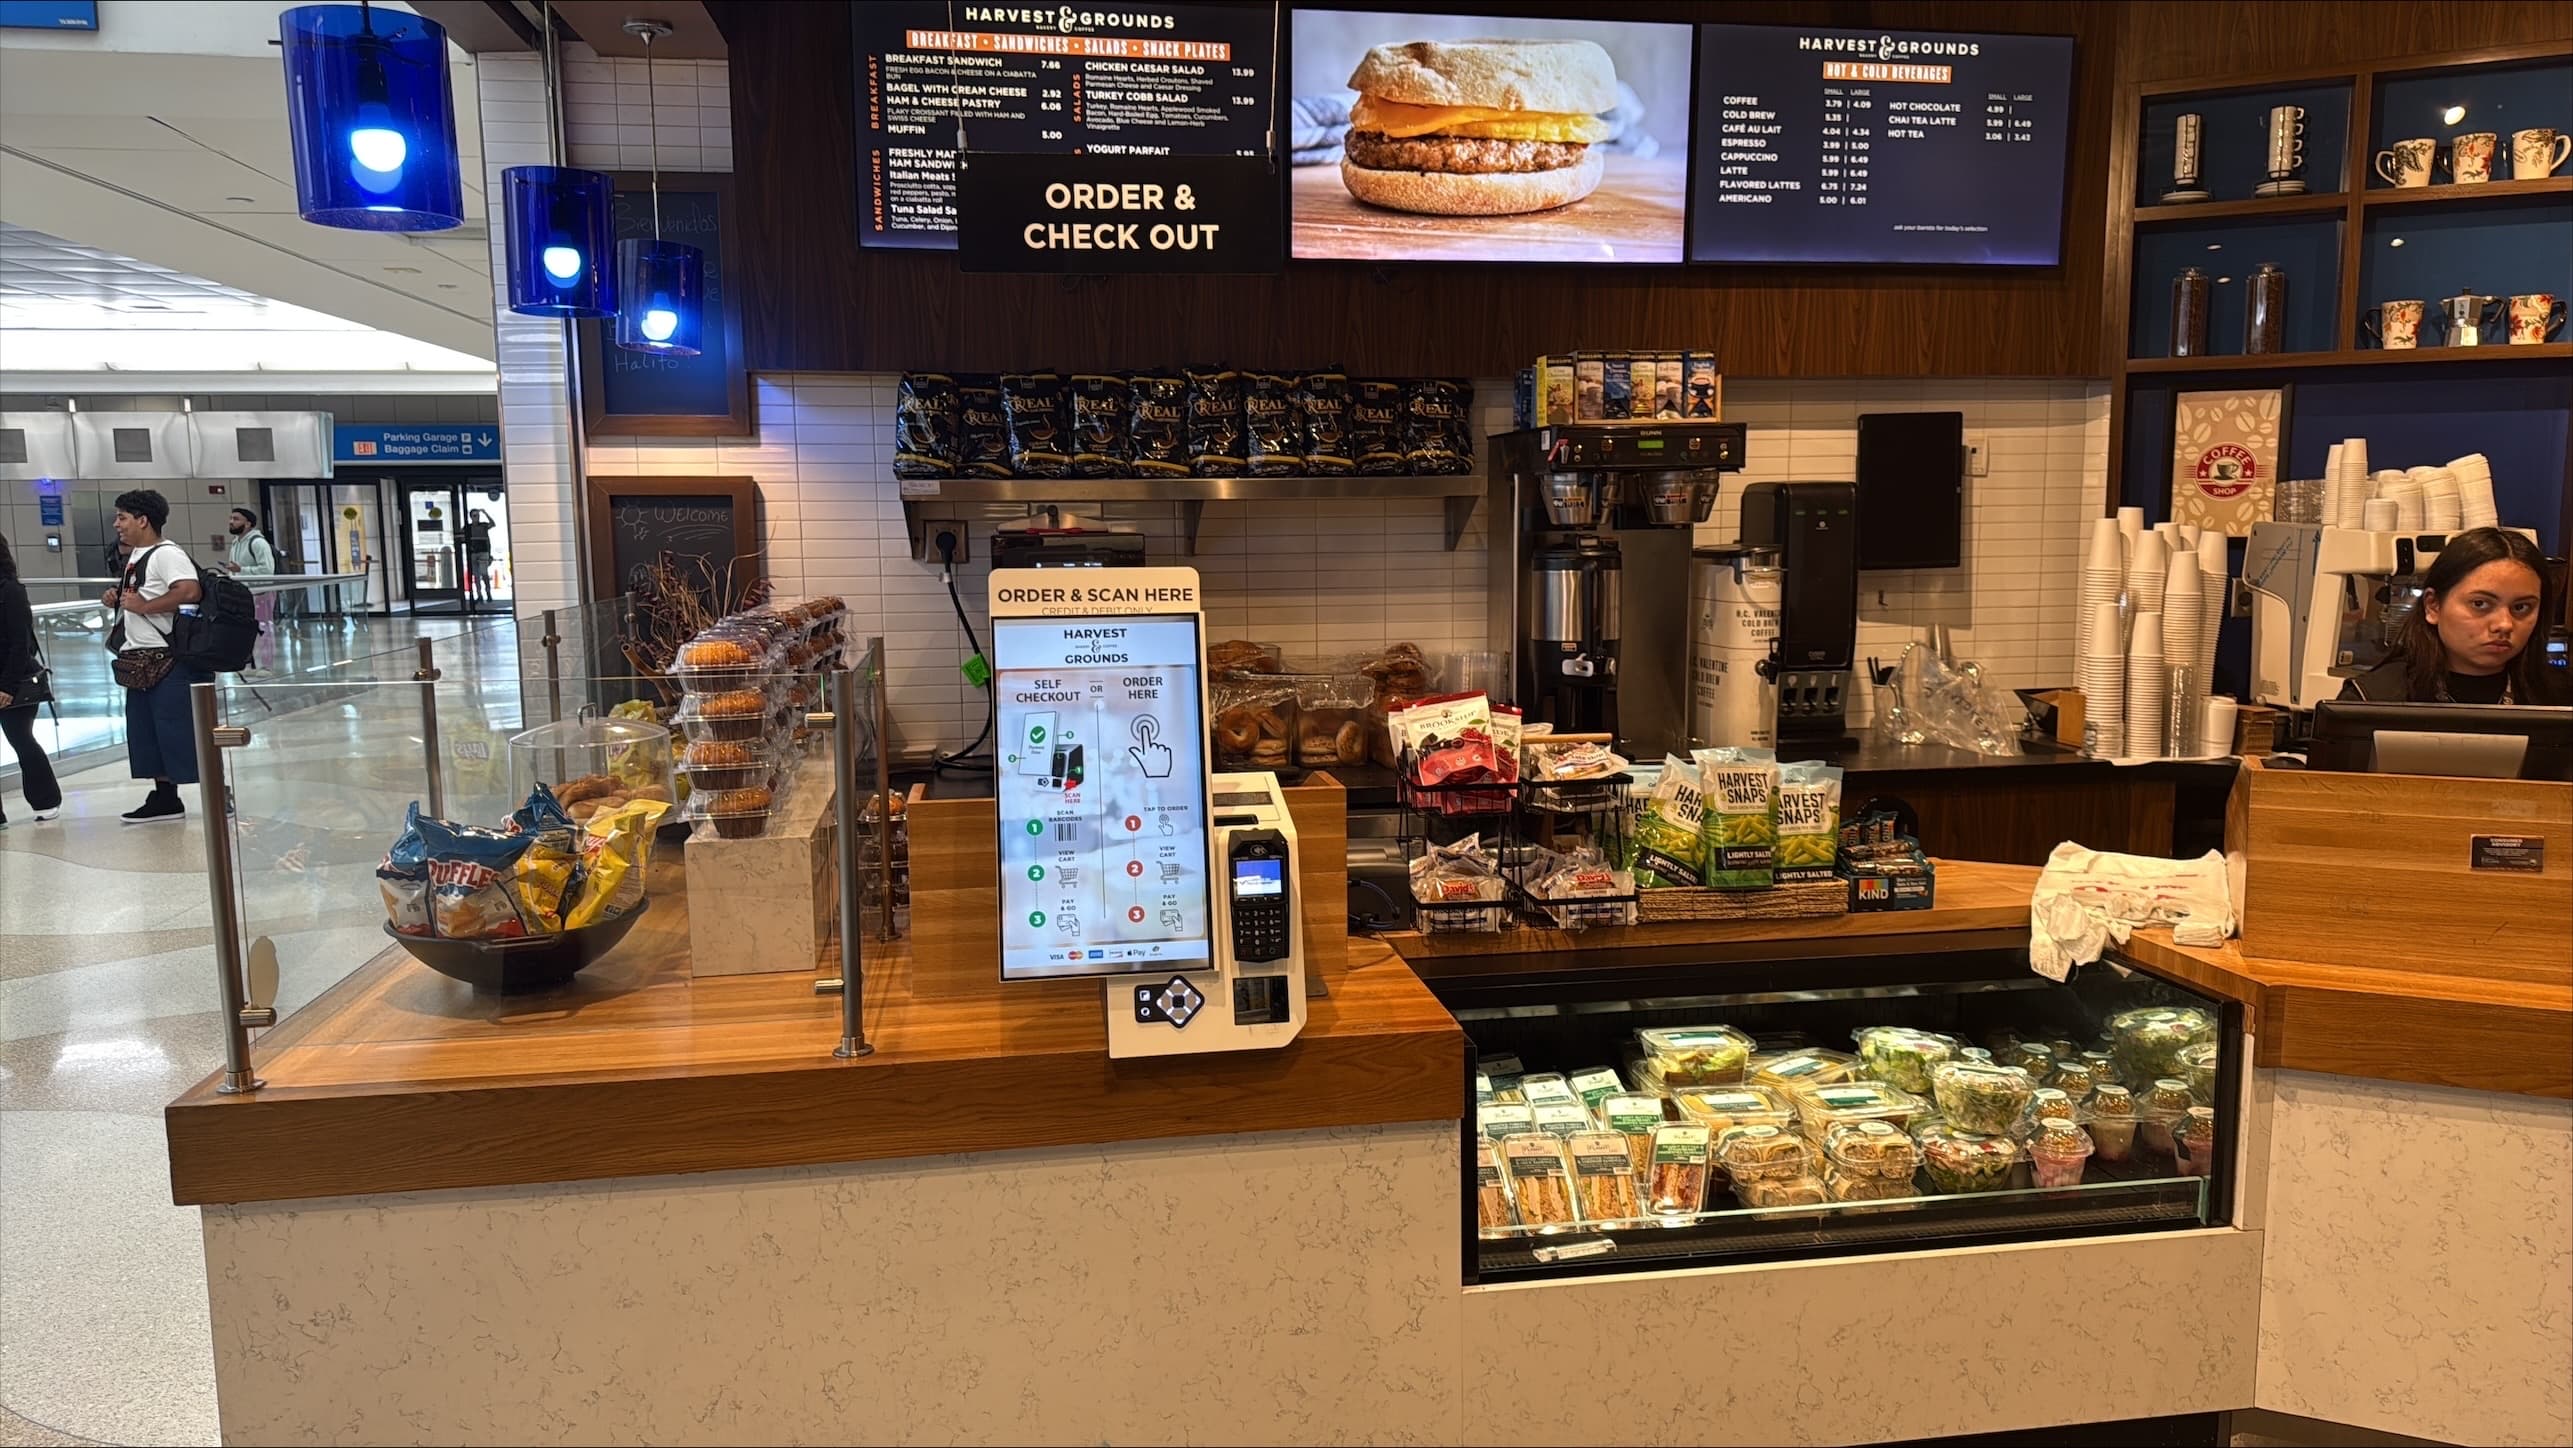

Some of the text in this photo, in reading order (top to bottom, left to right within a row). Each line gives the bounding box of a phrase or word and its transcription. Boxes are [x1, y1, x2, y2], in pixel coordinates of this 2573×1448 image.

[966, 5, 1175, 33] HARVEST & GROUNDS
[911, 32, 1226, 59] BREAKFAST SANDWICHES SALADS SNACK PLATES
[1799, 35, 1979, 60] HARVEST & GROUNDS
[885, 54, 944, 65] BREAKFAST
[947, 56, 1002, 67] SANDWICH
[1085, 62, 1128, 72] CHICKEN
[1130, 63, 1170, 74] CAESAR
[1172, 65, 1205, 75] SALAD
[1827, 64, 1948, 81] HOT & COLD BEVERAGES
[1003, 71, 1037, 79] CIABATTA
[868, 55, 880, 129] BREAKFAST
[886, 83, 1027, 97] BAGEL WITH CREAM CHEESE
[1073, 74, 1081, 122] SALADS
[1085, 90, 1188, 103] TURKEY COBB SALAD
[886, 96, 1001, 109] HAM & CHEESE PASTRY
[1723, 96, 1758, 105] COFFEE
[1853, 101, 1871, 109] 4.09
[1889, 102, 1961, 112] HOT CHOCOLATE
[1722, 111, 1776, 120] COLD BREW
[1888, 116, 1956, 126] CHAI TEA LATTE
[888, 125, 926, 135] MUFFIN
[1722, 123, 1745, 133] CAFÉ
[1762, 126, 1782, 134] LAIT
[1888, 130, 1924, 138] HOT TEA
[1721, 139, 1767, 147] ESPRESSO
[888, 148, 933, 158] FRESHLY
[1086, 144, 1170, 156] YOGURT PARFAIT
[889, 159, 912, 167] HAM
[1721, 153, 1778, 162] CAPPUCCINO
[889, 170, 950, 181] Italian Meats
[1720, 167, 1748, 175] LATTE
[872, 150, 883, 231] SANDWICHES
[1719, 181, 1766, 189] FLAVORED
[1768, 181, 1800, 190] LATTES
[1045, 182, 1197, 211] ORDER &
[1719, 195, 1772, 203] AMERICANO
[890, 205, 943, 214] Tuna Salad
[1023, 223, 1220, 250] CHECK OUT
[383, 433, 458, 443] Parking Garage
[384, 445, 459, 454] Baggage Claim
[2203, 446, 2251, 465] COFFEE
[998, 588, 1193, 602] ORDER & SCAN HERE
[1042, 607, 1080, 615] CREDIT
[1092, 607, 1122, 615] DEBIT
[1064, 629, 1127, 639] HARVEST
[1091, 639, 1102, 653] &
[1065, 654, 1129, 664] GROUNDS
[1034, 680, 1062, 689] SELF
[1123, 677, 1163, 687] ORDER
[1016, 691, 1080, 702] CHECKOUT
[1128, 690, 1158, 699] HERE
[1717, 773, 1768, 789] HARVEST
[1728, 788, 1766, 804] SNAPS
[1778, 793, 1825, 809] ARVEST
[1777, 809, 1820, 825] SNAPS
[1727, 851, 1754, 859] LIGHTLY
[1650, 854, 1679, 871] LIGHTLY
[1775, 870, 1833, 879] LIGHTLY SALTED
[1858, 889, 1888, 900] KIND
[1133, 949, 1145, 957] Pay
